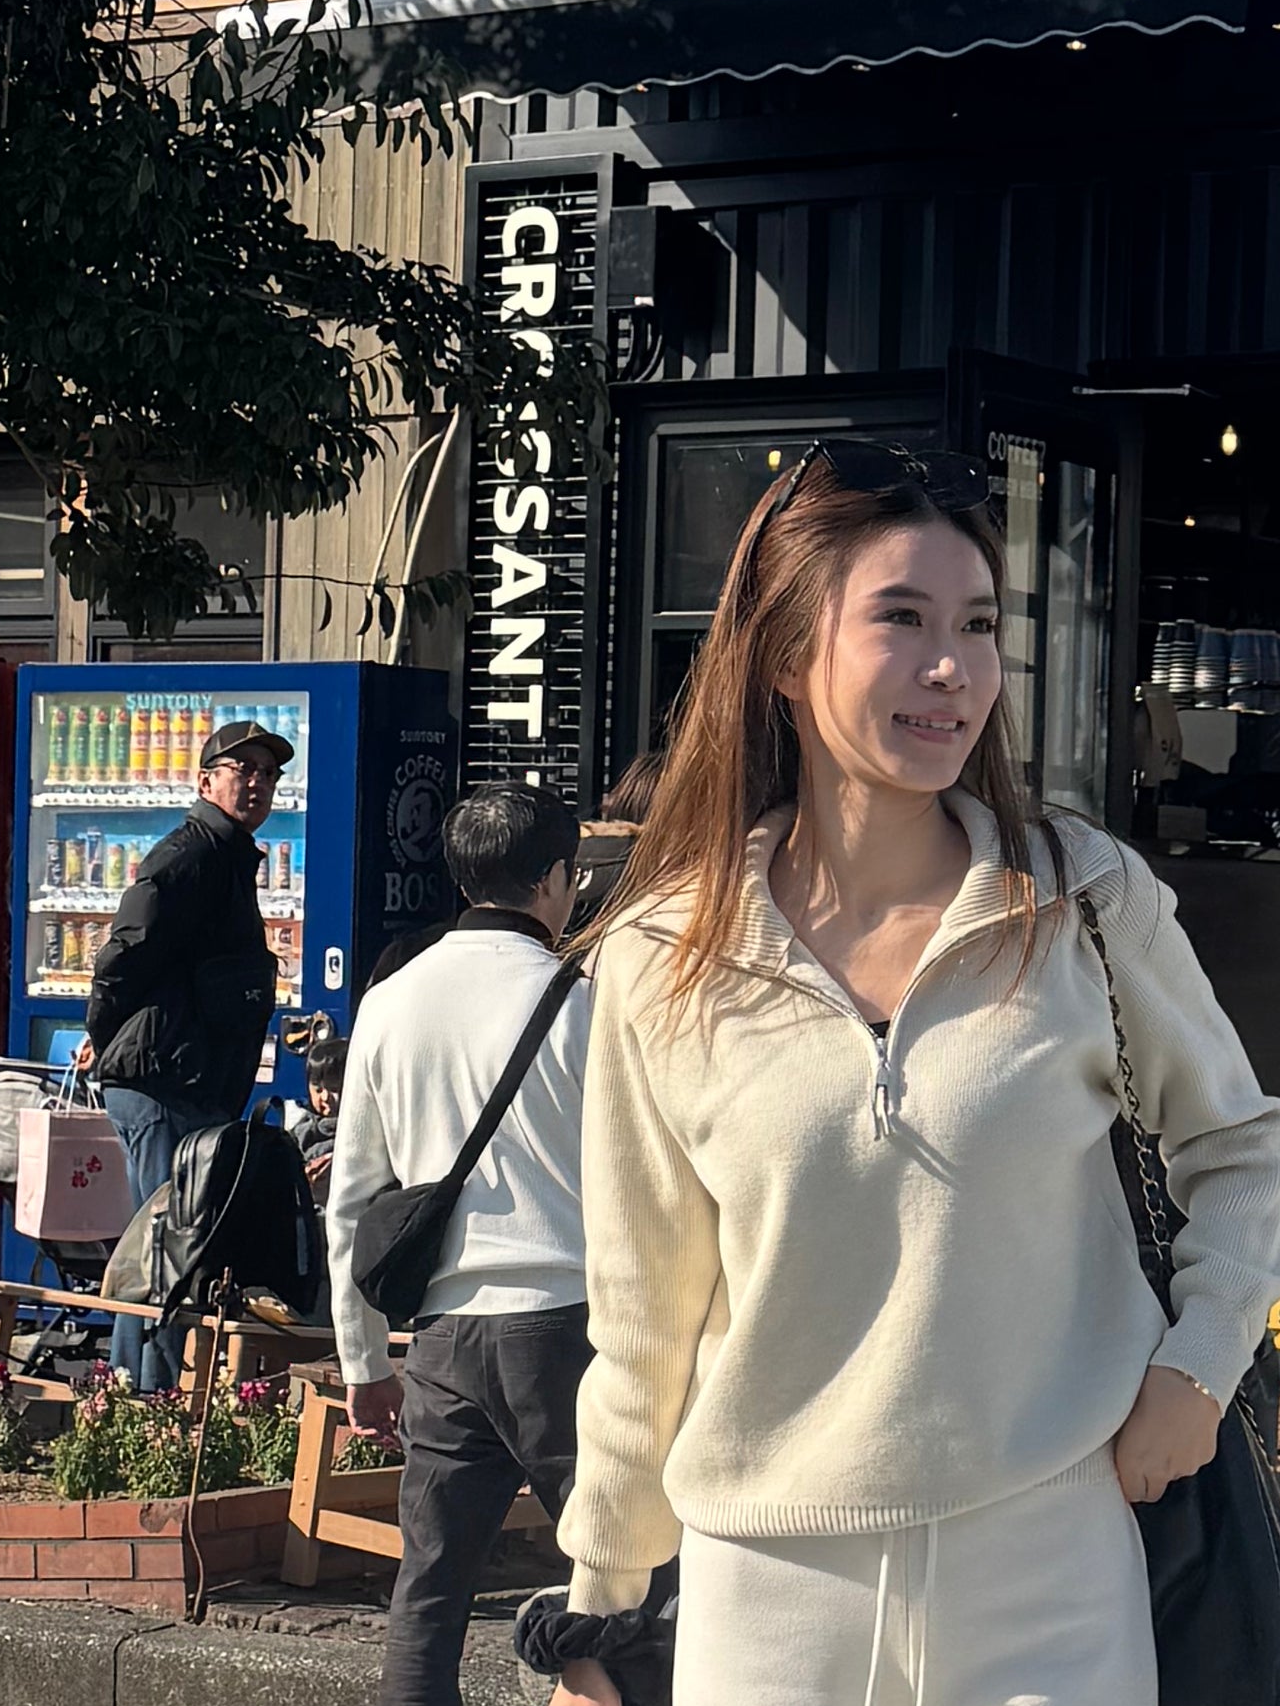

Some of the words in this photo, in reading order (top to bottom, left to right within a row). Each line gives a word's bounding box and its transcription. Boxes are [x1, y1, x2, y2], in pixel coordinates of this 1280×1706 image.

[486, 205, 559, 738] CRSSANT
[126, 693, 212, 710] SUNTORY
[400, 729, 447, 744] SUNTORY
[384, 871, 440, 912] BOS
